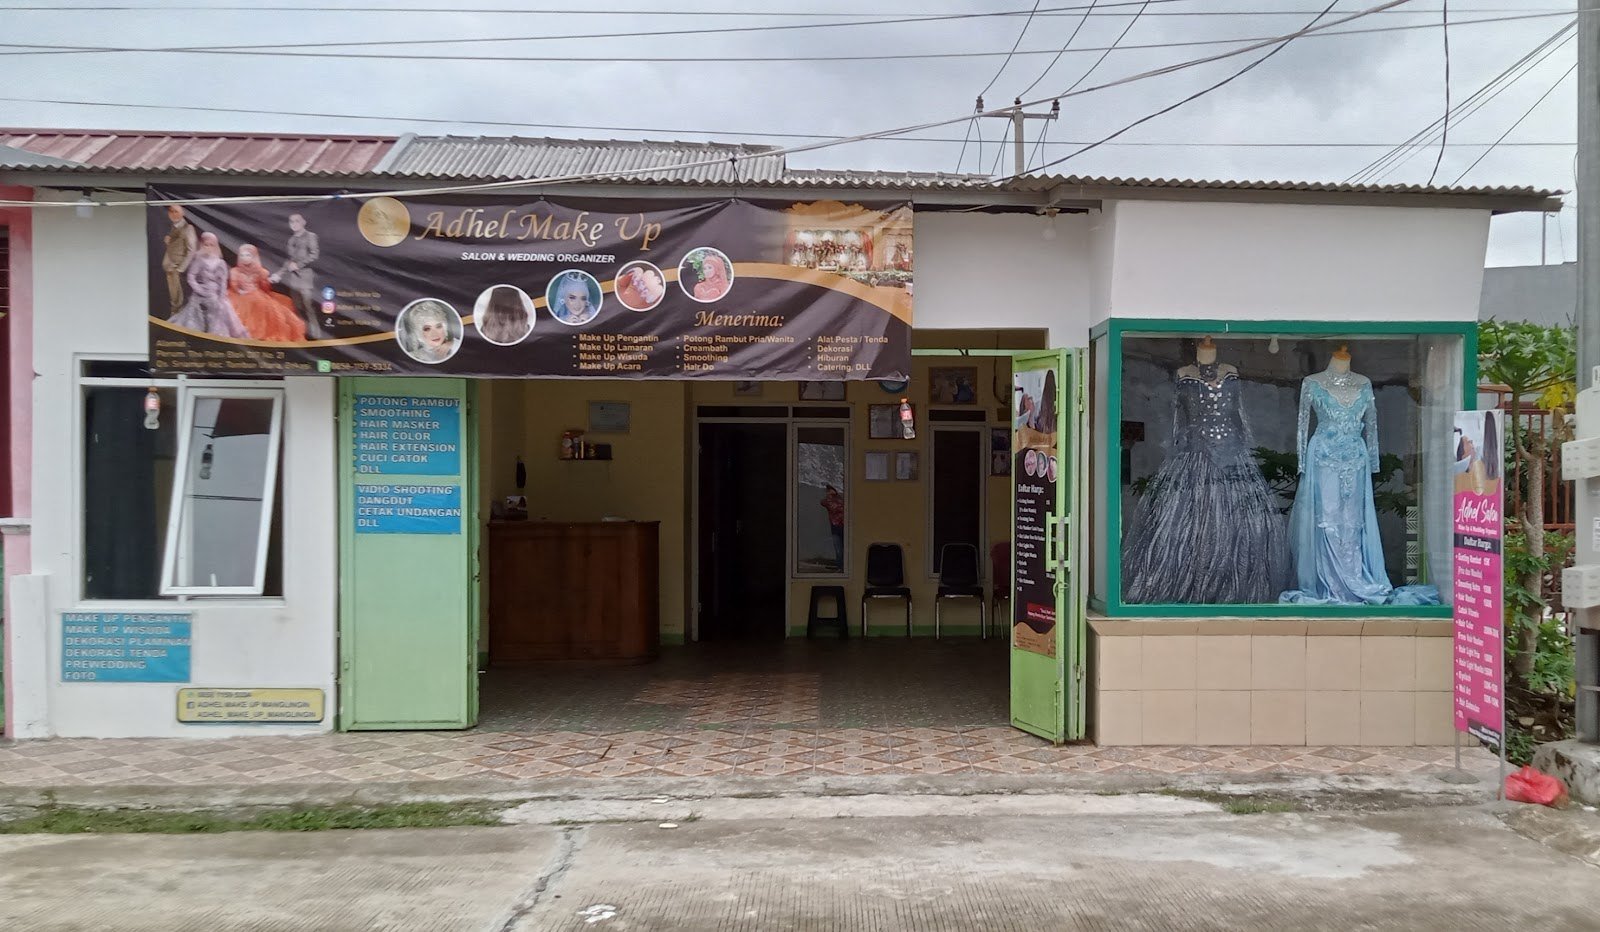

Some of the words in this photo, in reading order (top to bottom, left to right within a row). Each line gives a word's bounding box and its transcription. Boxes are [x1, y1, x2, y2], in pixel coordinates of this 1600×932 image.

[414, 208, 516, 241] Adhel
[516, 211, 604, 247] Make
[614, 212, 662, 251] Up
[460, 252, 496, 262] SALON
[497, 253, 506, 262] &
[507, 253, 555, 263] WEDDING
[556, 253, 617, 264] ORGANIZER
[694, 310, 784, 327] Menerima:
[579, 334, 602, 342] Make
[603, 334, 616, 344] Up
[616, 334, 659, 344] Pengantin
[683, 335, 714, 344] Potong
[715, 335, 748, 343] Rambut
[748, 335, 795, 343] Pria/Wanita
[817, 336, 834, 344] Alat
[834, 336, 859, 344] Pesta
[863, 336, 889, 344] Tenda
[579, 343, 602, 352] Make
[603, 343, 616, 353] Up
[616, 343, 654, 352] Lamaran
[683, 344, 729, 353] Creambath
[817, 345, 853, 353] Dekorasi
[579, 353, 602, 361] Make
[603, 353, 616, 362] Up
[616, 353, 649, 361] Wisuda
[683, 353, 729, 363] Smoothing
[817, 354, 850, 362] Hiburan
[579, 362, 602, 371] Make
[603, 362, 616, 372] Up
[616, 362, 642, 370] Acara
[683, 362, 702, 371] Hair
[702, 362, 715, 371] Do
[855, 363, 873, 371] DLL
[360, 397, 408, 407] POTONG
[411, 398, 461, 408] RAMBUT
[360, 408, 431, 418] SMOOTHING
[360, 420, 389, 429] HAIR
[391, 420, 441, 430] MASKER
[360, 431, 389, 440] HAIR
[391, 432, 431, 441] COLOR
[360, 443, 389, 451] HAIR
[391, 443, 456, 453] EXTENSION
[360, 454, 388, 463] CUCI
[390, 454, 429, 463] CATOK
[360, 465, 381, 474] DLL
[358, 485, 391, 494] VIDIO
[393, 486, 453, 496] SHOOTING
[358, 496, 414, 505] DANGDUT
[358, 507, 395, 516] CETAK
[397, 508, 461, 518] UNDANGAN
[358, 518, 380, 527] DLL
[65, 614, 100, 623] MAKE
[102, 614, 119, 623] UP
[65, 625, 100, 634] MAKE
[102, 625, 119, 634] UP
[122, 625, 171, 635] WISUDA
[65, 637, 126, 646] DEKORASI
[65, 648, 126, 658] DEKORASI
[128, 648, 168, 658] TENDA
[65, 659, 147, 669] PREWEDDING
[65, 671, 97, 680] FOTO
